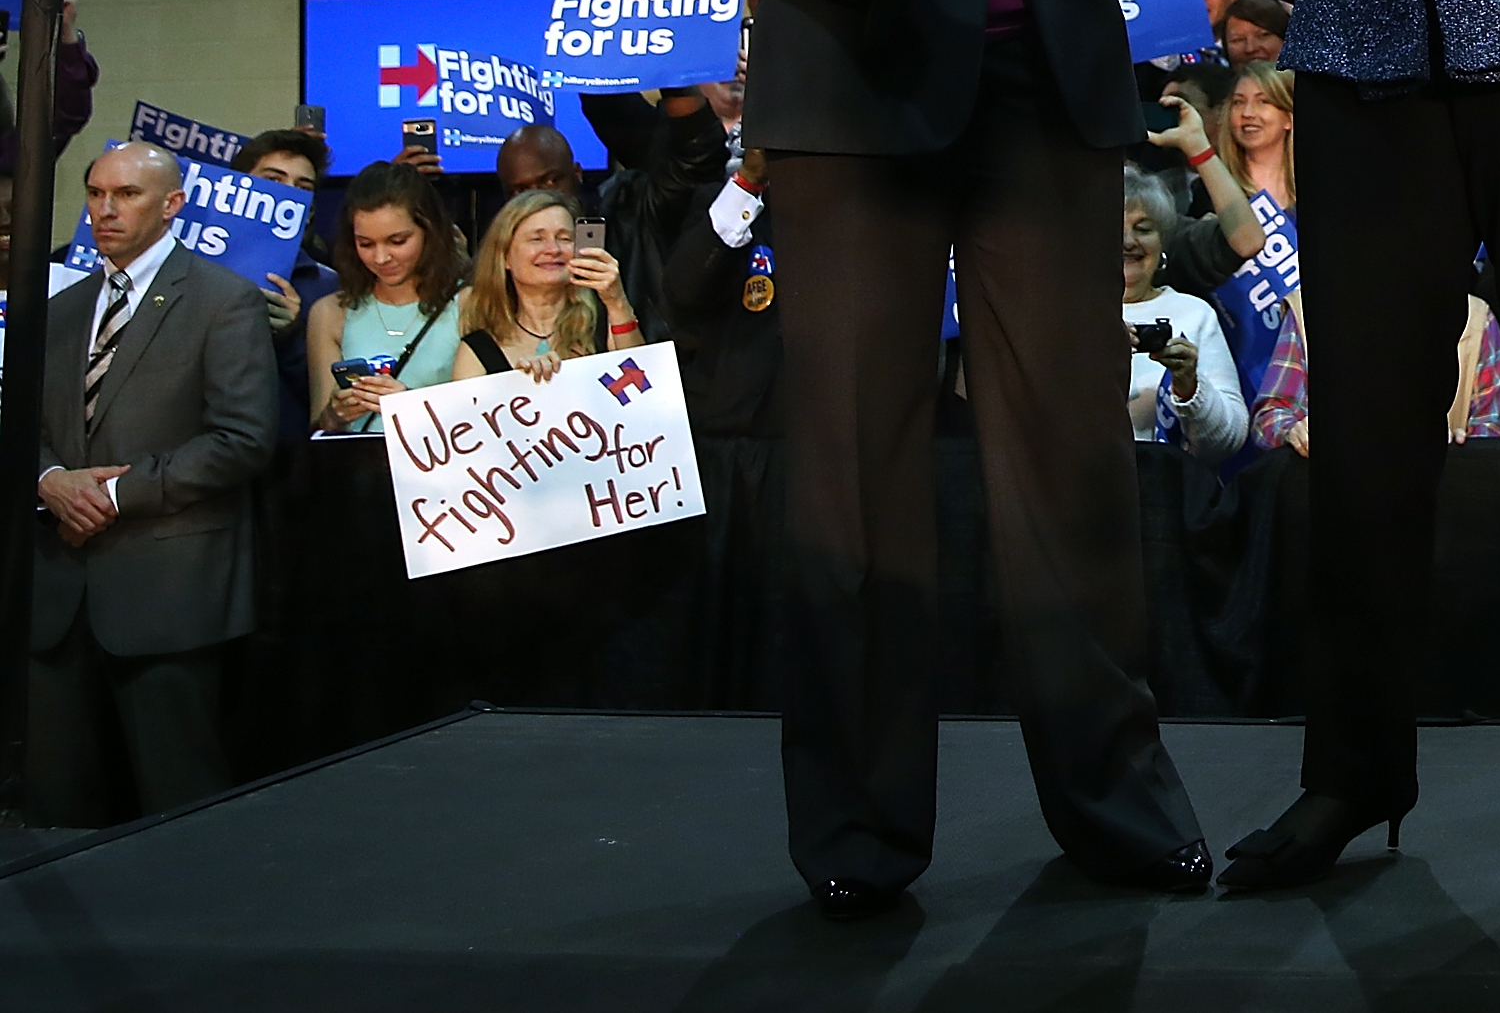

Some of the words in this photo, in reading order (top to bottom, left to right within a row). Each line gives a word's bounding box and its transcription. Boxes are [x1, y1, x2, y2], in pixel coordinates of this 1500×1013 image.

[544, 20, 615, 57] for
[619, 27, 676, 56] us
[437, 49, 555, 117] Fighting
[439, 80, 495, 116] for
[499, 94, 536, 124] us
[135, 103, 244, 163] Fighti
[180, 162, 306, 240] hting
[1248, 280, 1283, 330] us
[392, 394, 541, 472] We're
[411, 410, 609, 552] fighting
[606, 423, 666, 474] for
[584, 466, 684, 528] Her!
